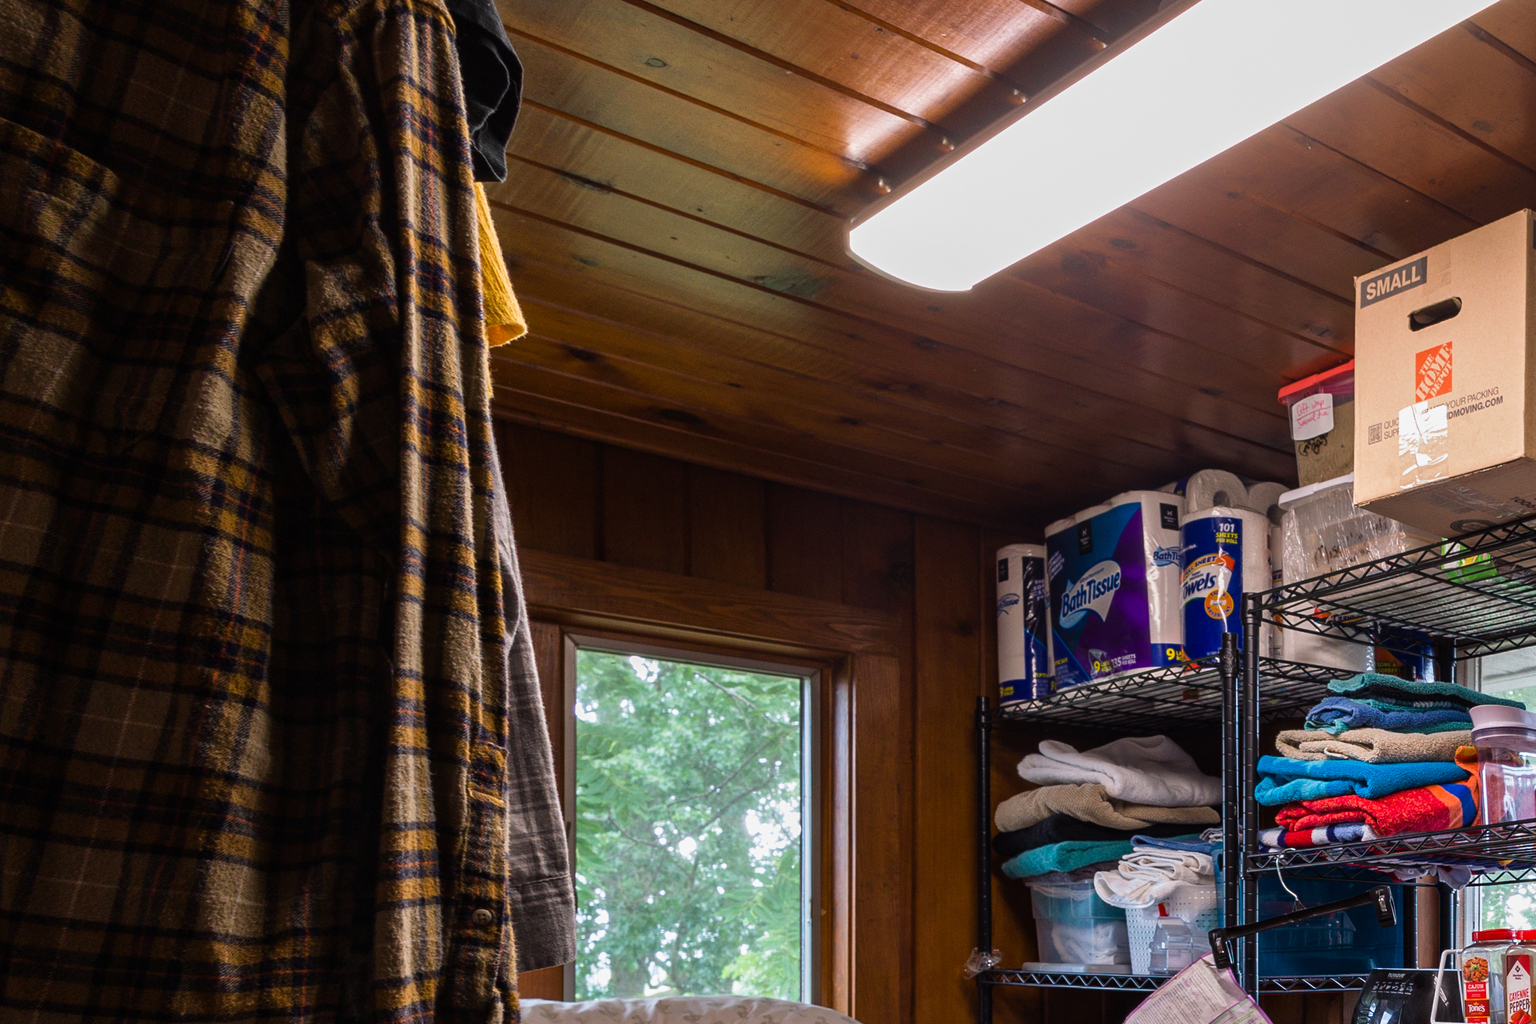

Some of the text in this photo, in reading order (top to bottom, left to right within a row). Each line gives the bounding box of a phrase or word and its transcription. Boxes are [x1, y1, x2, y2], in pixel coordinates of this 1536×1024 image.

[1365, 265, 1422, 301] SMALL
[1415, 342, 1452, 401] HOME
[1418, 353, 1436, 377] THE
[1429, 361, 1453, 398] DEPOT
[1446, 396, 1467, 409] YOUR
[1467, 386, 1500, 403] PACKING
[1446, 395, 1504, 420] DMOVING.COM
[1219, 523, 1235, 532] 101
[1194, 555, 1217, 567] SHEET
[1165, 648, 1176, 661] 9
[1093, 660, 1101, 673] 9
[1509, 988, 1530, 1002] CAYENNE
[1467, 1003, 1486, 1013] Tone's
[1509, 998, 1530, 1014] PEPPER
